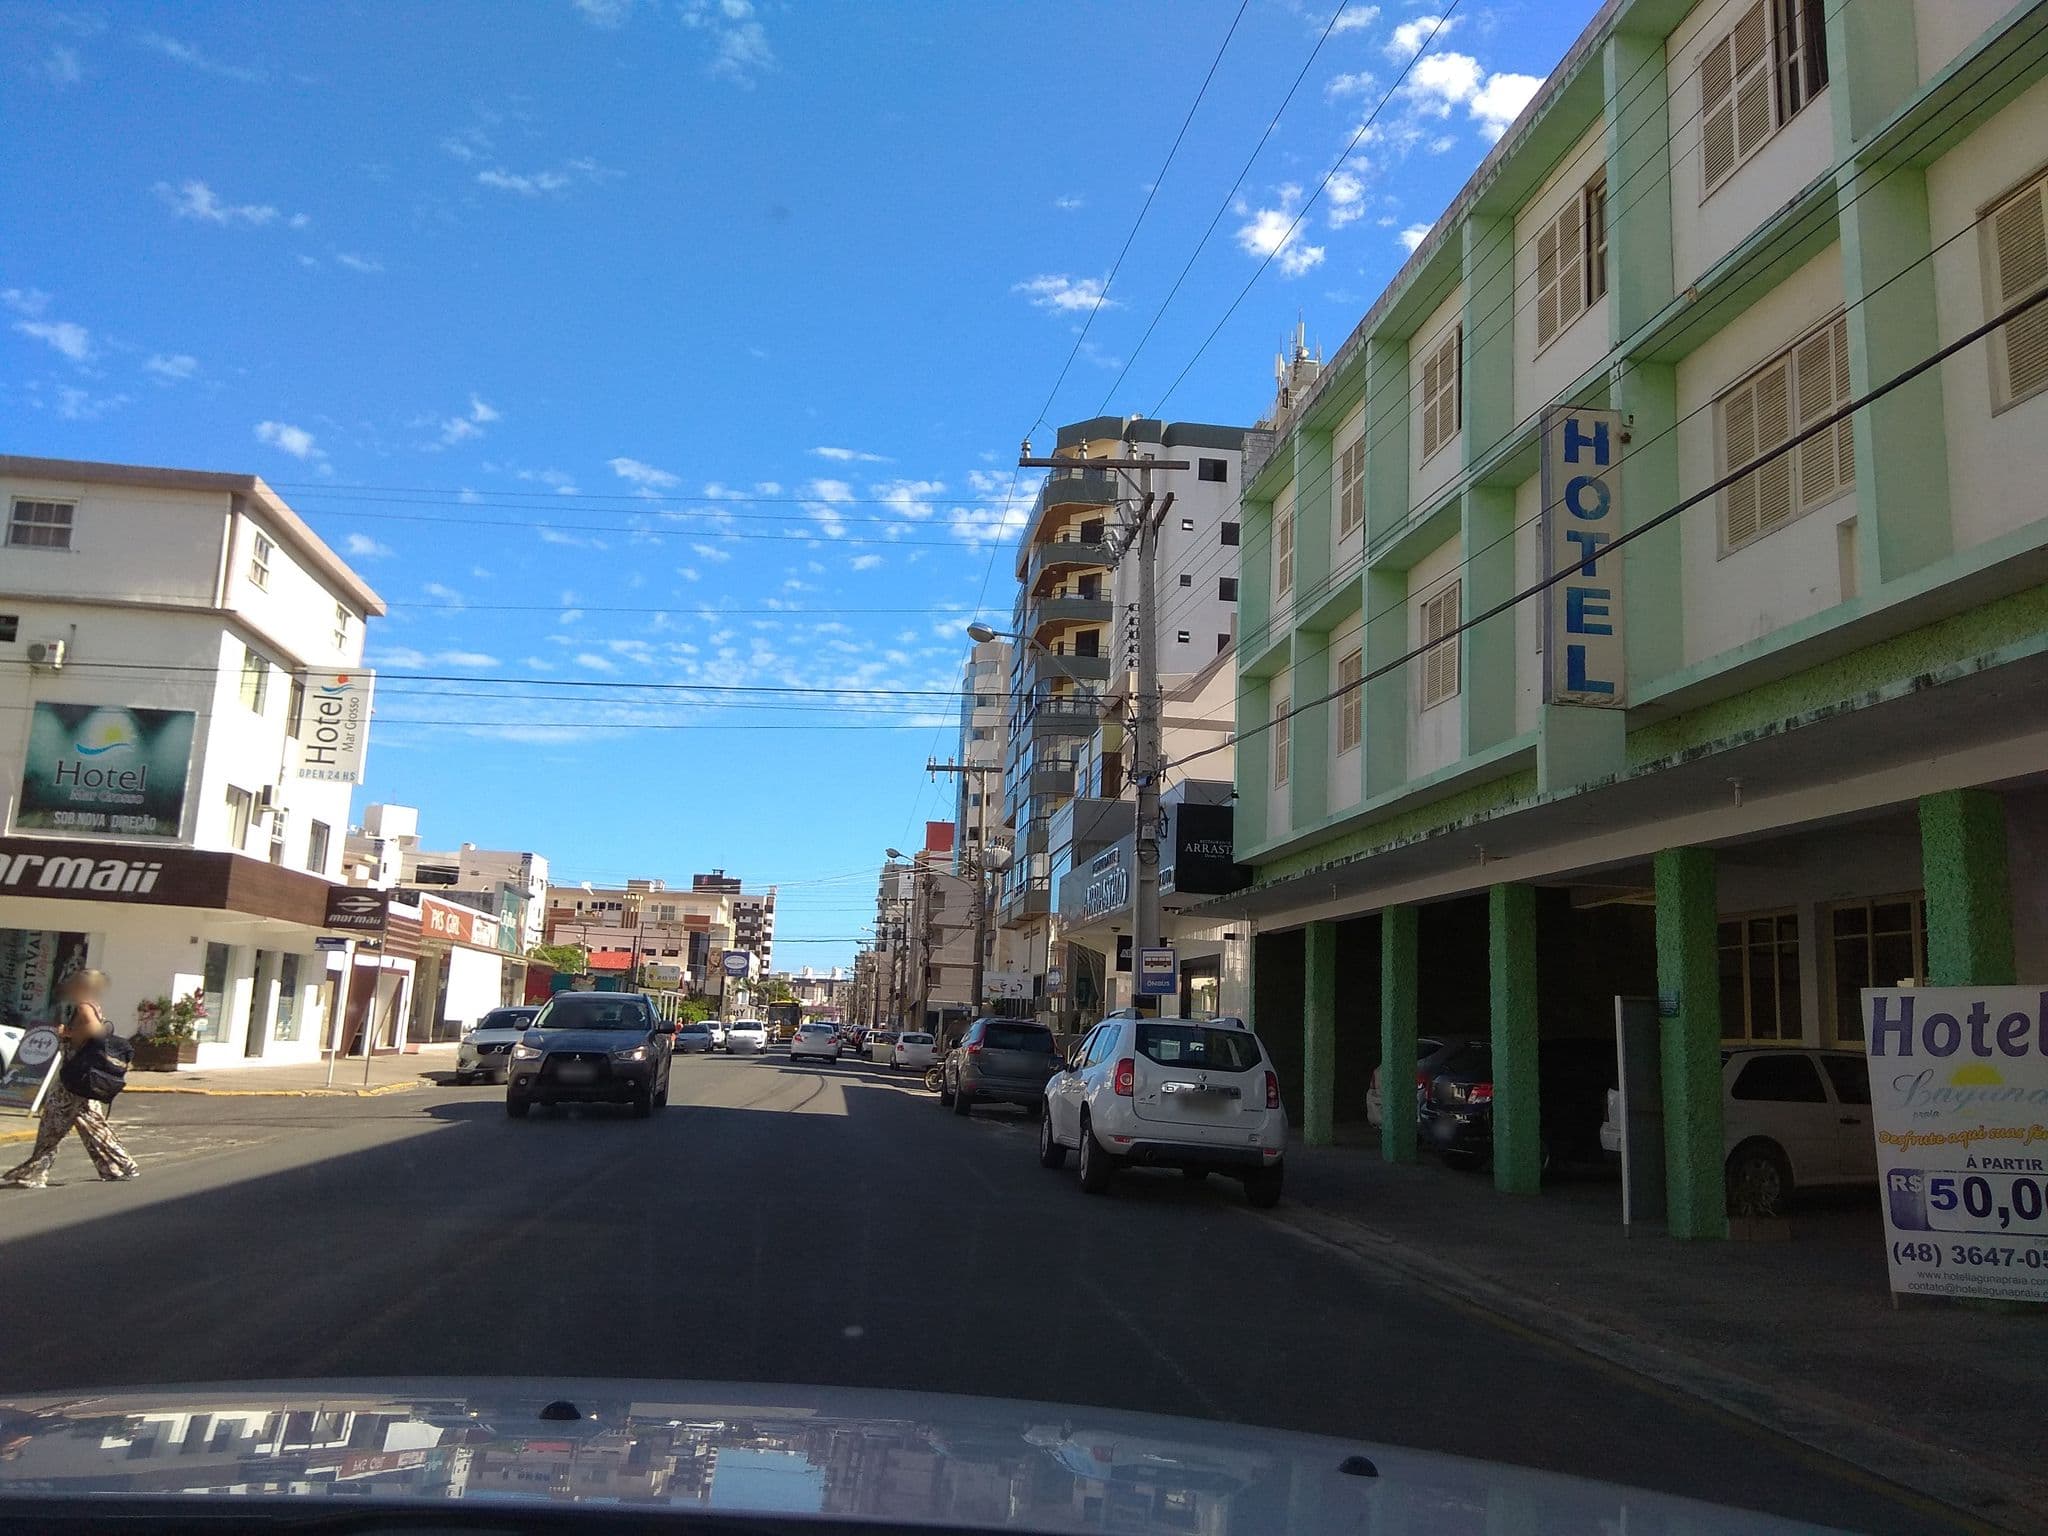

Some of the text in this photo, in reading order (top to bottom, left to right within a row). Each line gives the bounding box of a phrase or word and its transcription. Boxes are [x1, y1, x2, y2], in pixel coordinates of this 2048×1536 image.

[1564, 419, 1615, 694] HOTEL
[305, 694, 343, 765] Hotel
[342, 697, 360, 752] Mar Grosso
[56, 760, 146, 790] Hotel
[299, 768, 356, 780] OPEN 24 HS
[54, 811, 157, 831] SOB NOVA DIREÇÃO
[1185, 843, 1233, 855] ARRAST
[328, 914, 382, 924] mormaii
[1879, 1130, 1945, 1152] Desfrute
[1949, 1124, 1985, 1149] aqui
[1988, 1127, 2025, 1139] suas
[1982, 1157, 2044, 1171] PARTIR
[1890, 1174, 2048, 1229] R$ 50,0
[1893, 1241, 1942, 1267] (48)
